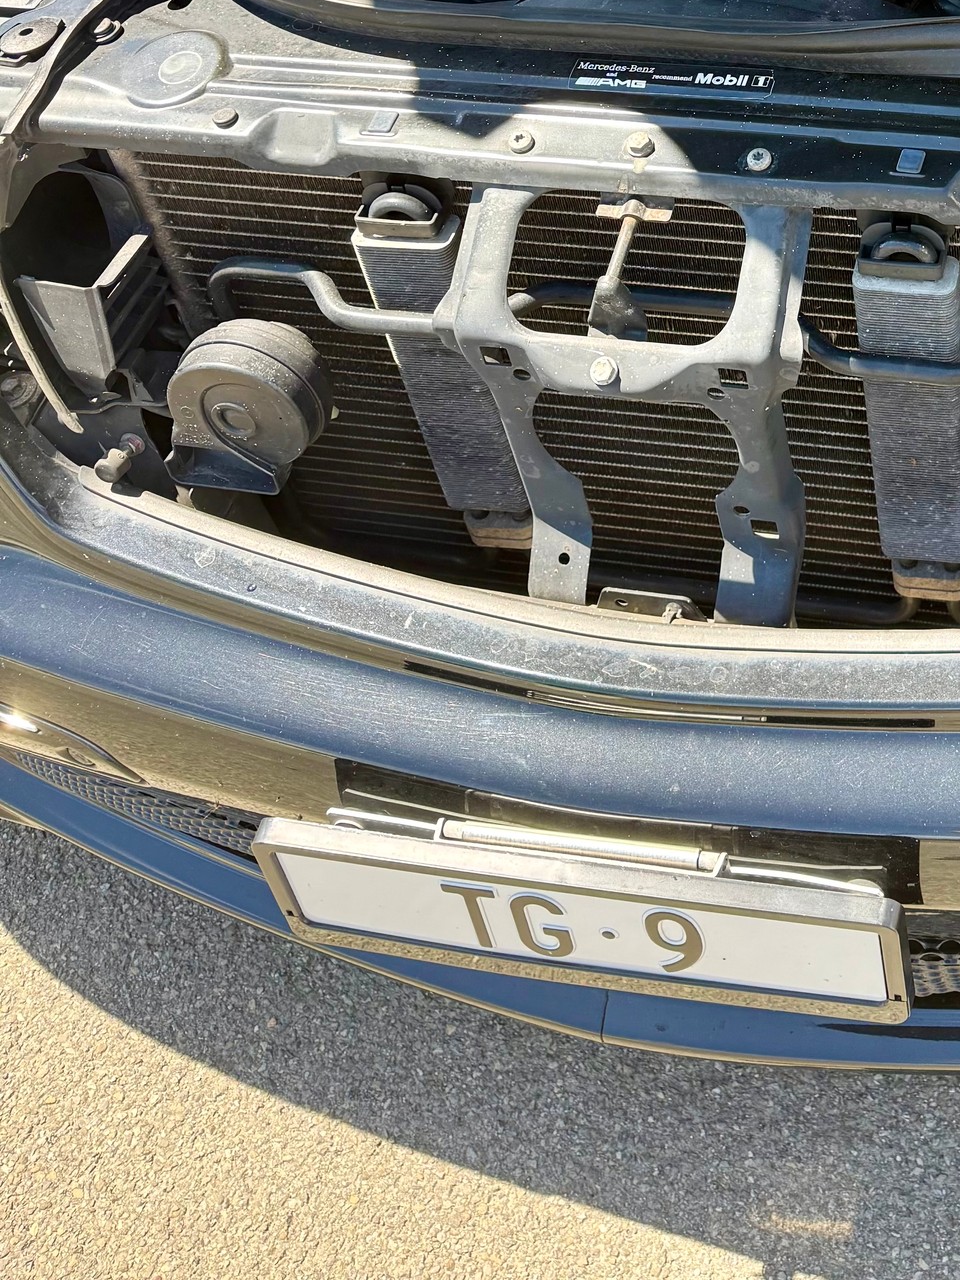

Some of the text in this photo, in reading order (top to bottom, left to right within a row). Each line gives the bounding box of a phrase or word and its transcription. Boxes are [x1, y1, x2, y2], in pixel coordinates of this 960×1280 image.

[577, 61, 655, 74] Mercedes-Benz
[598, 77, 647, 89] AMG
[652, 74, 693, 82] recommend
[694, 72, 750, 87] Mobil
[439, 882, 573, 957] TG
[642, 906, 705, 973] 9
